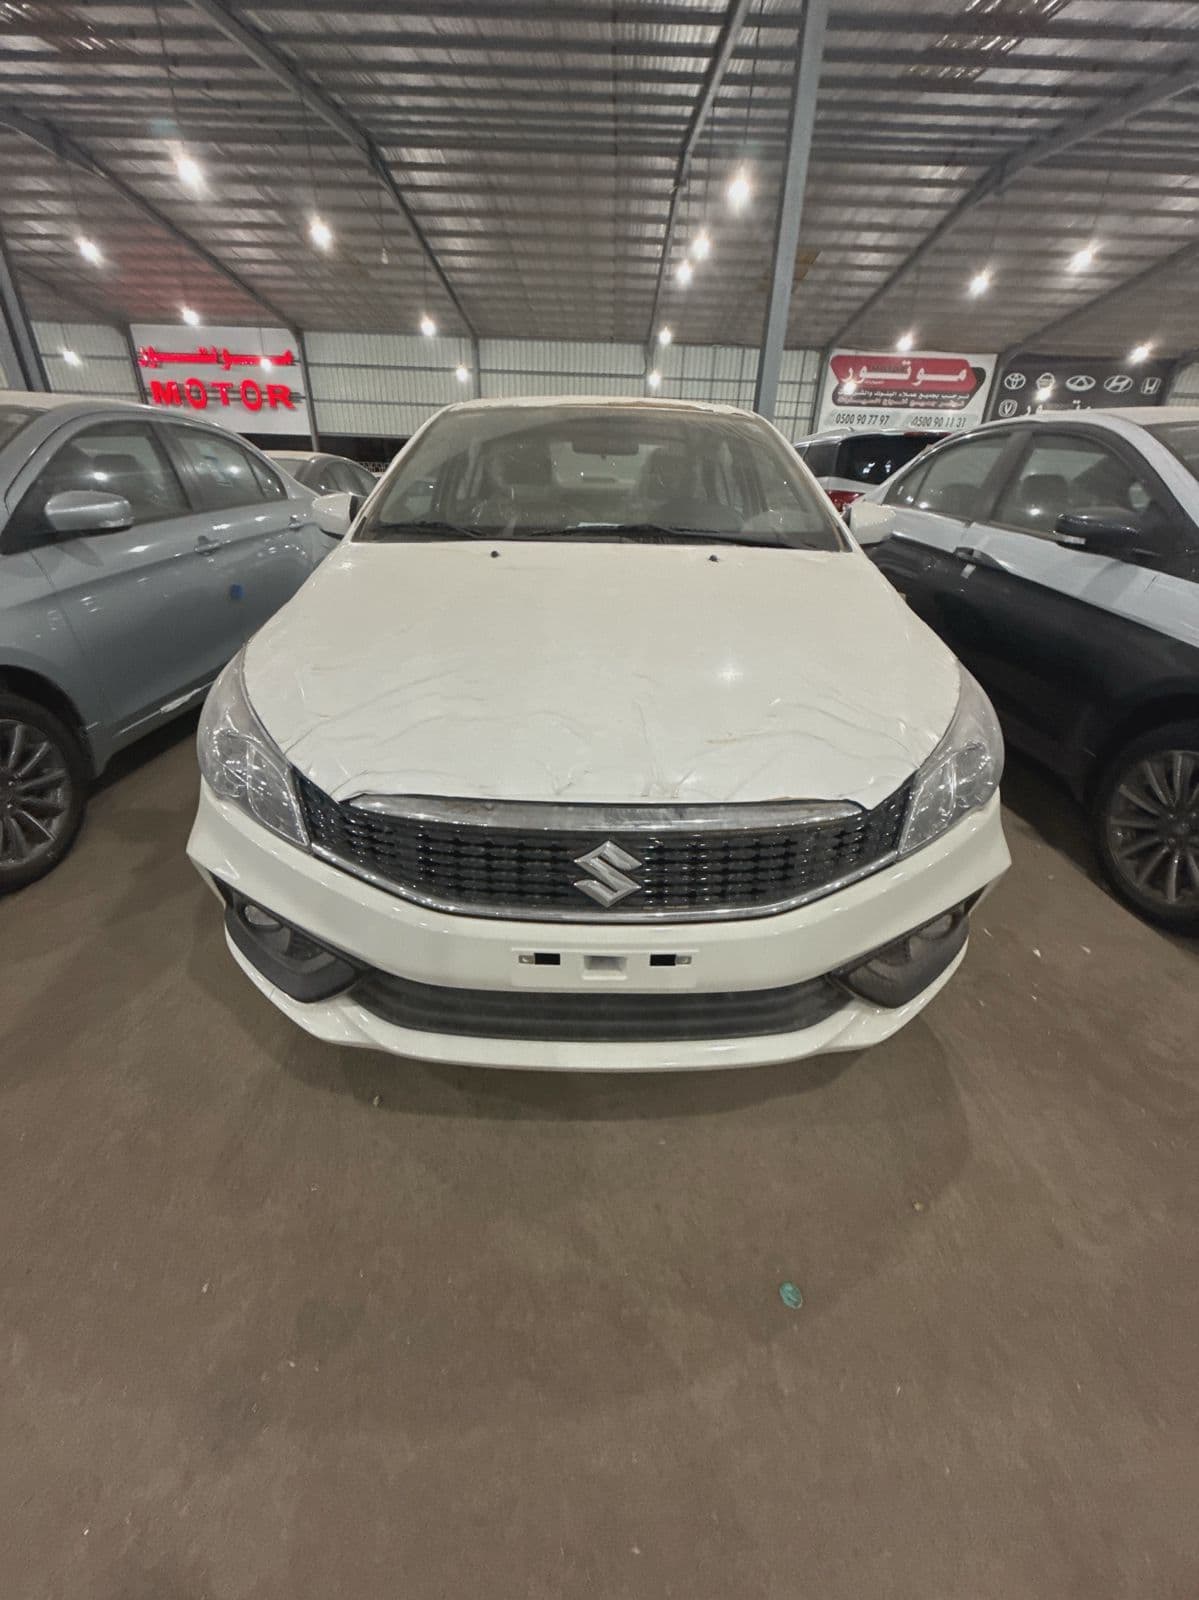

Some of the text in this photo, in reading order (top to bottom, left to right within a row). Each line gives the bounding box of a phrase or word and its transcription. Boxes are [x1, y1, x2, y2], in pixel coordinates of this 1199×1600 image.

[841, 361, 967, 386] موتور
[150, 377, 295, 412] MOTOR
[835, 413, 890, 426] 0500 90 77 97
[911, 416, 932, 427] 0500
[933, 416, 944, 428] 90
